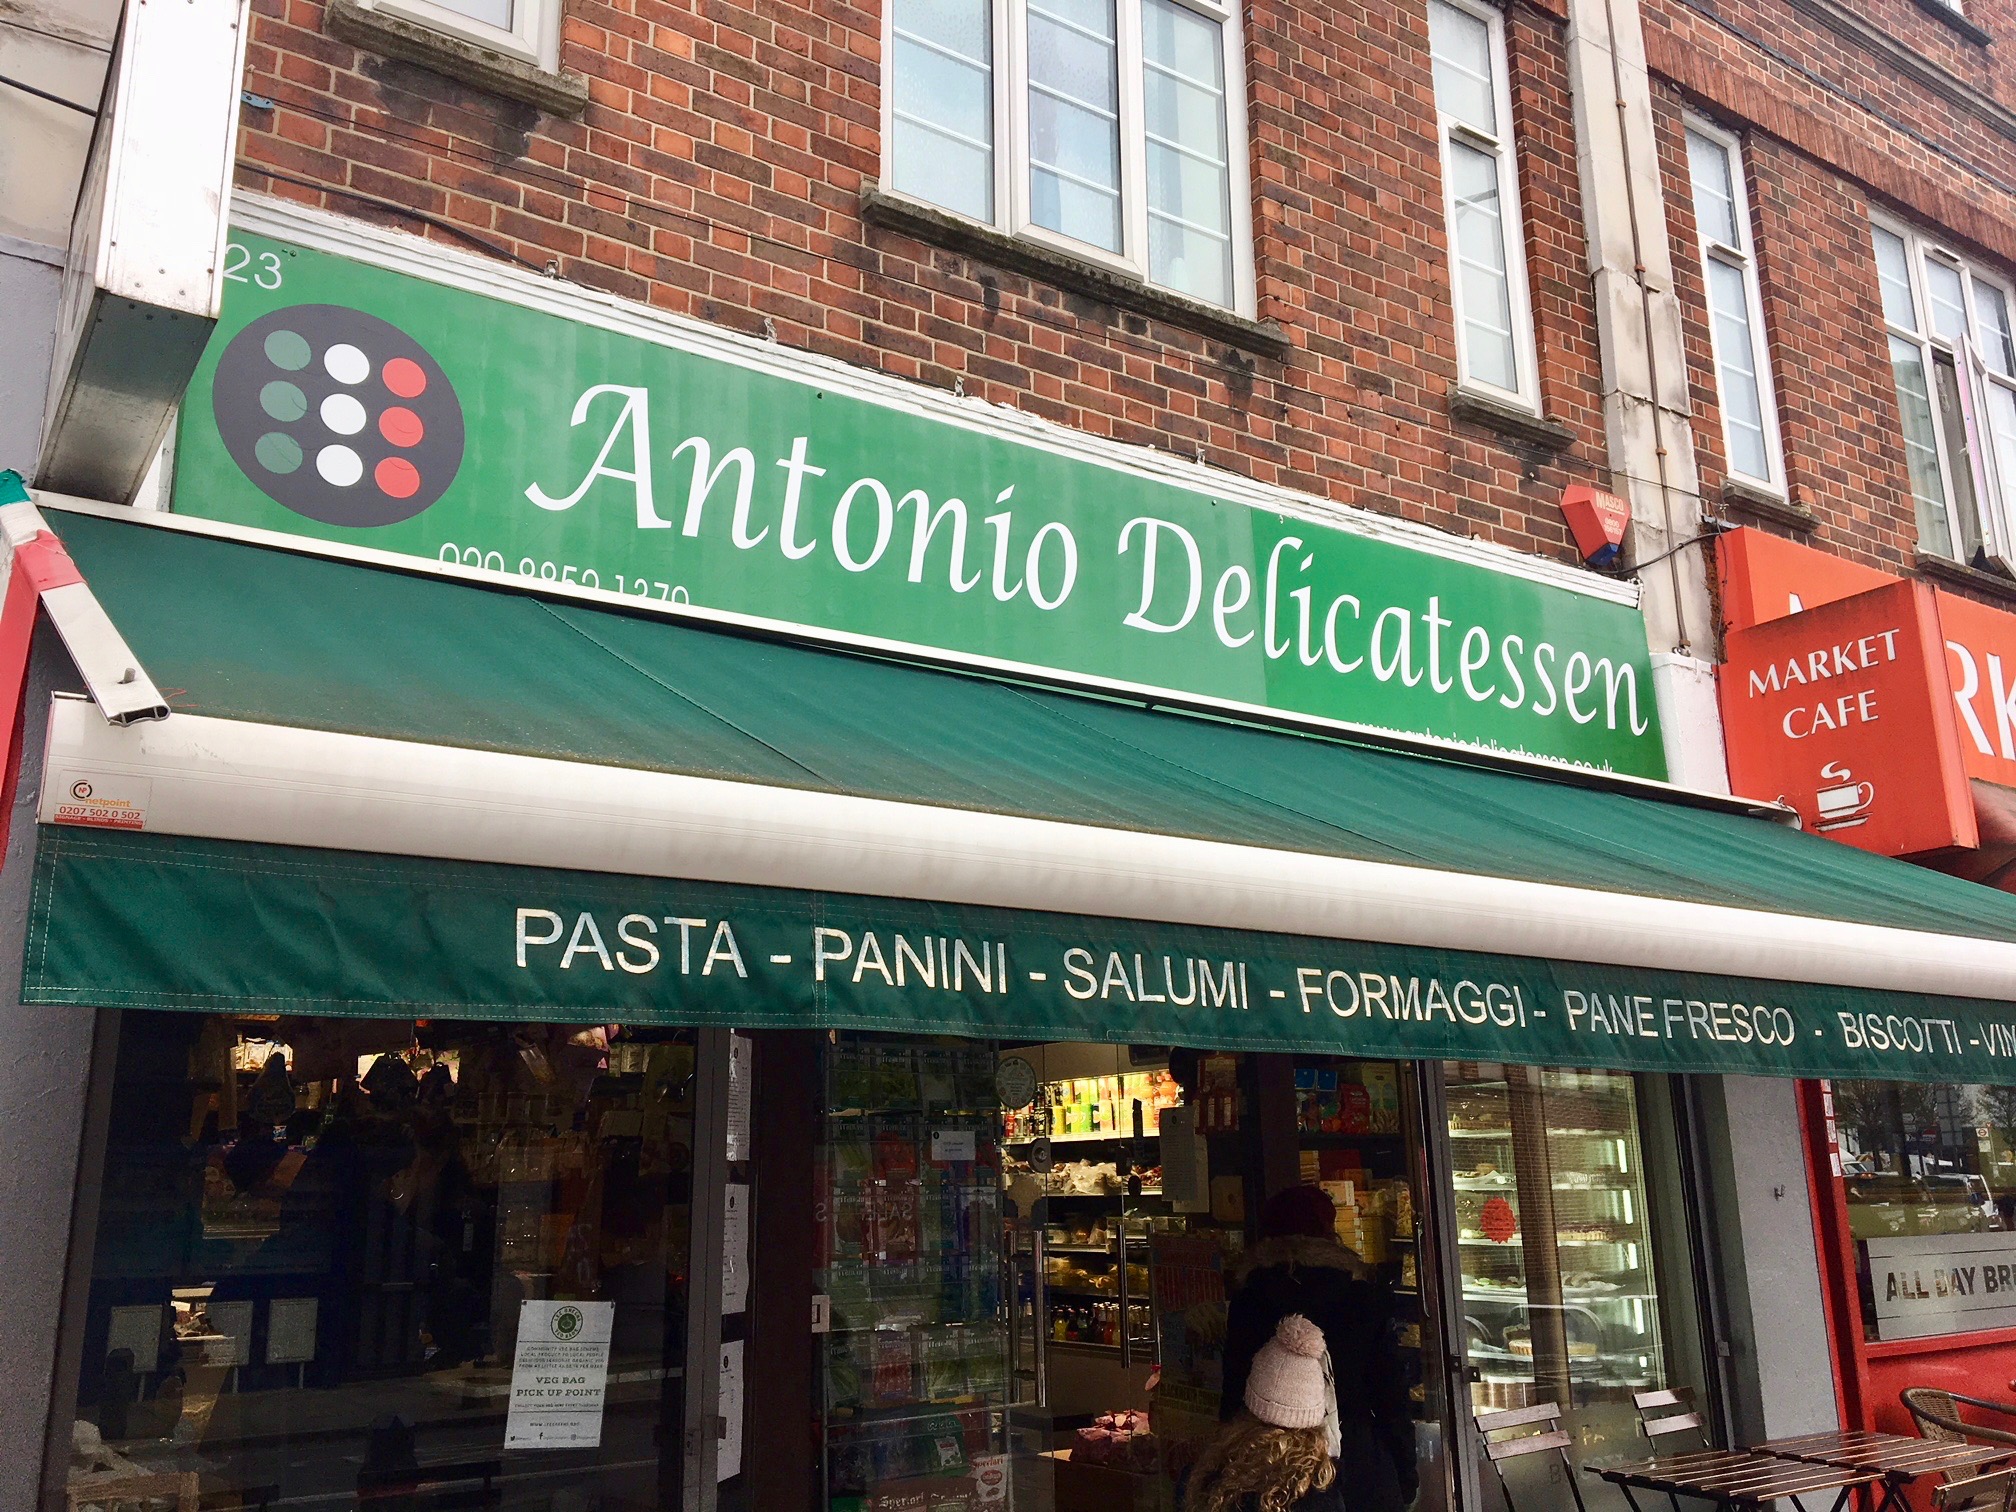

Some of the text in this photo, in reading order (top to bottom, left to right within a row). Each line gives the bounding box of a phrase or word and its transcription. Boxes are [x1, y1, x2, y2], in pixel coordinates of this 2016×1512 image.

[1595, 491, 1624, 512] MASCO
[523, 383, 1649, 737] Antonio Delicatessen
[1748, 628, 1900, 699] MARKET
[1782, 689, 1880, 739] CAFE
[59, 806, 87, 816] 0207
[89, 808, 109, 818] 502
[121, 811, 140, 820] 502
[515, 907, 748, 979] PASTA
[815, 927, 1008, 994] PANINI
[1063, 947, 1250, 1011] SALUMI
[1296, 967, 1527, 1028] FORMAGGI
[1564, 989, 1659, 1037] PANE
[1663, 998, 1796, 1047] FRESCO
[1838, 1011, 1963, 1056] BISCOTTI
[1886, 1270, 1930, 1302] ALL
[1935, 1266, 1976, 1297] DAY
[516, 1388, 602, 1397] PICK UP POINT
[535, 1376, 586, 1384] VEG BAG
